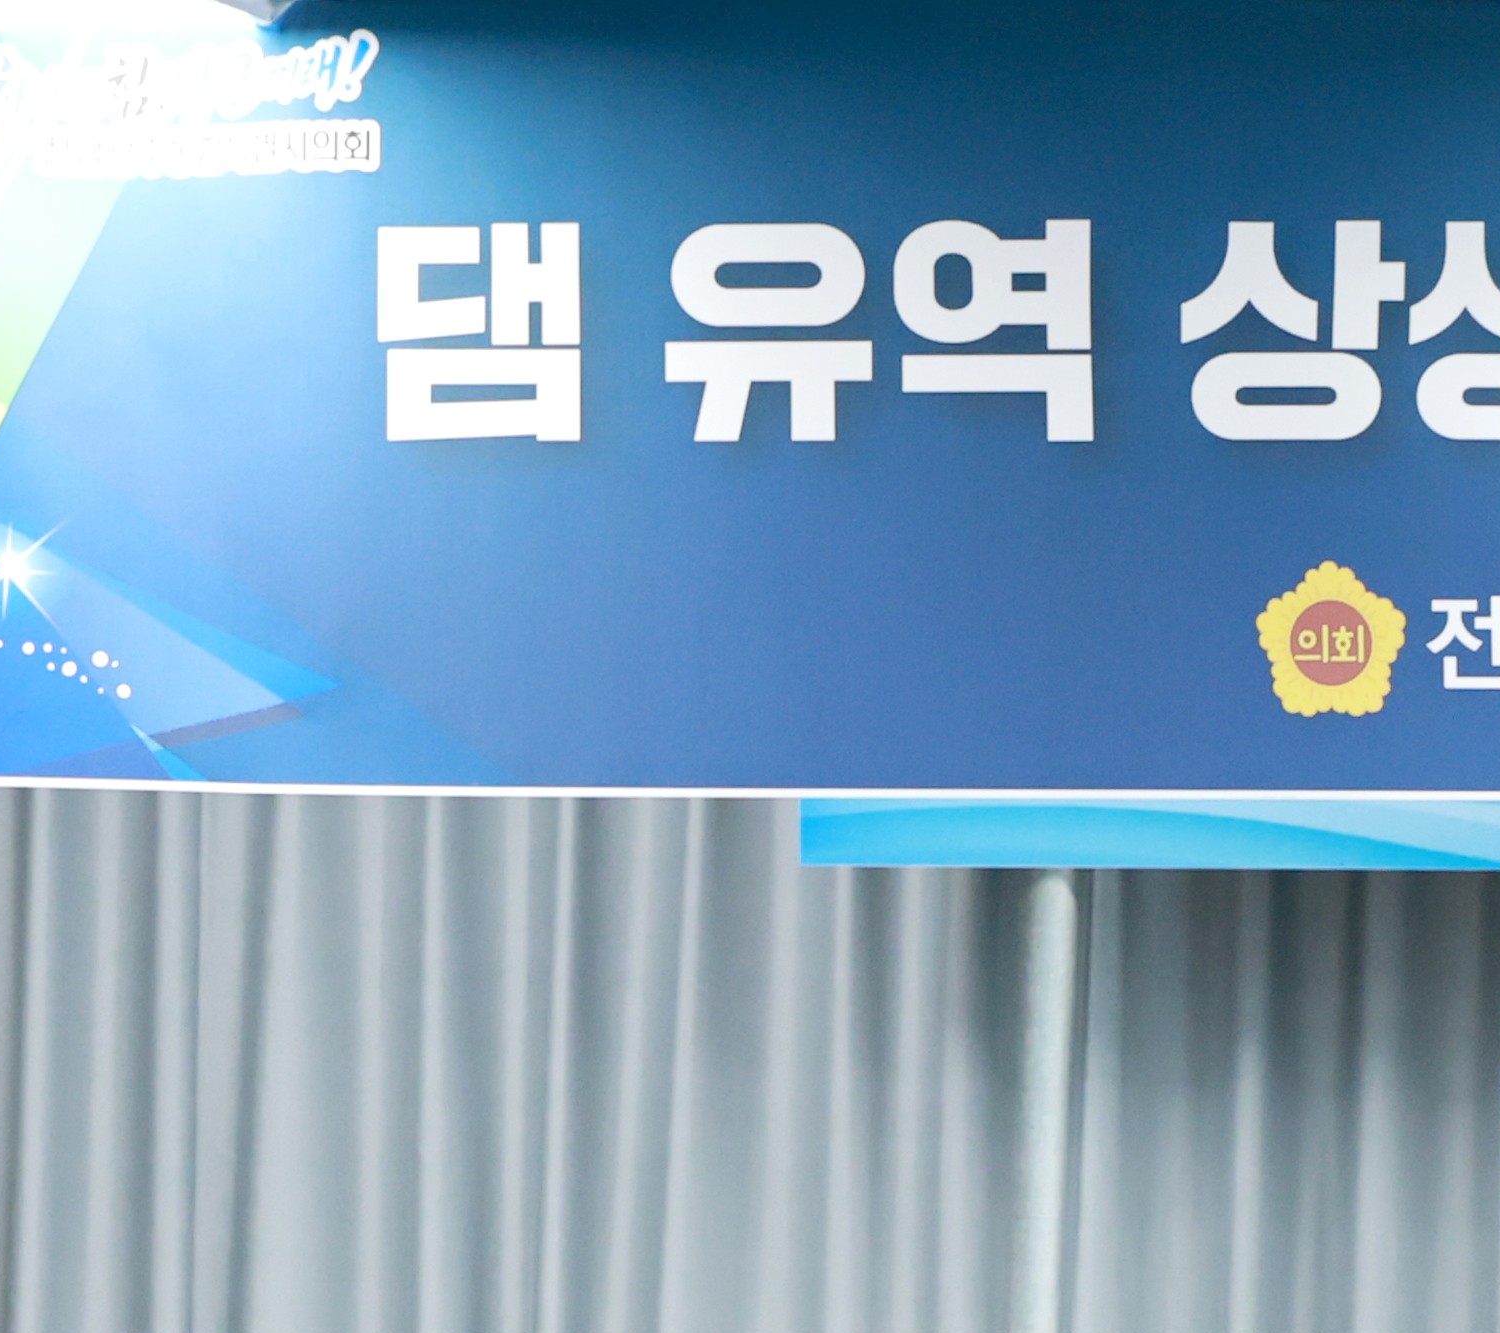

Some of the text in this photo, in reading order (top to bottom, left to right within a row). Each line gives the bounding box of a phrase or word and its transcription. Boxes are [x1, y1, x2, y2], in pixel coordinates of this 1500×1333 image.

[376, 221, 582, 442] 댐
[664, 219, 1094, 442] 유역
[1292, 626, 1368, 665] 의회
